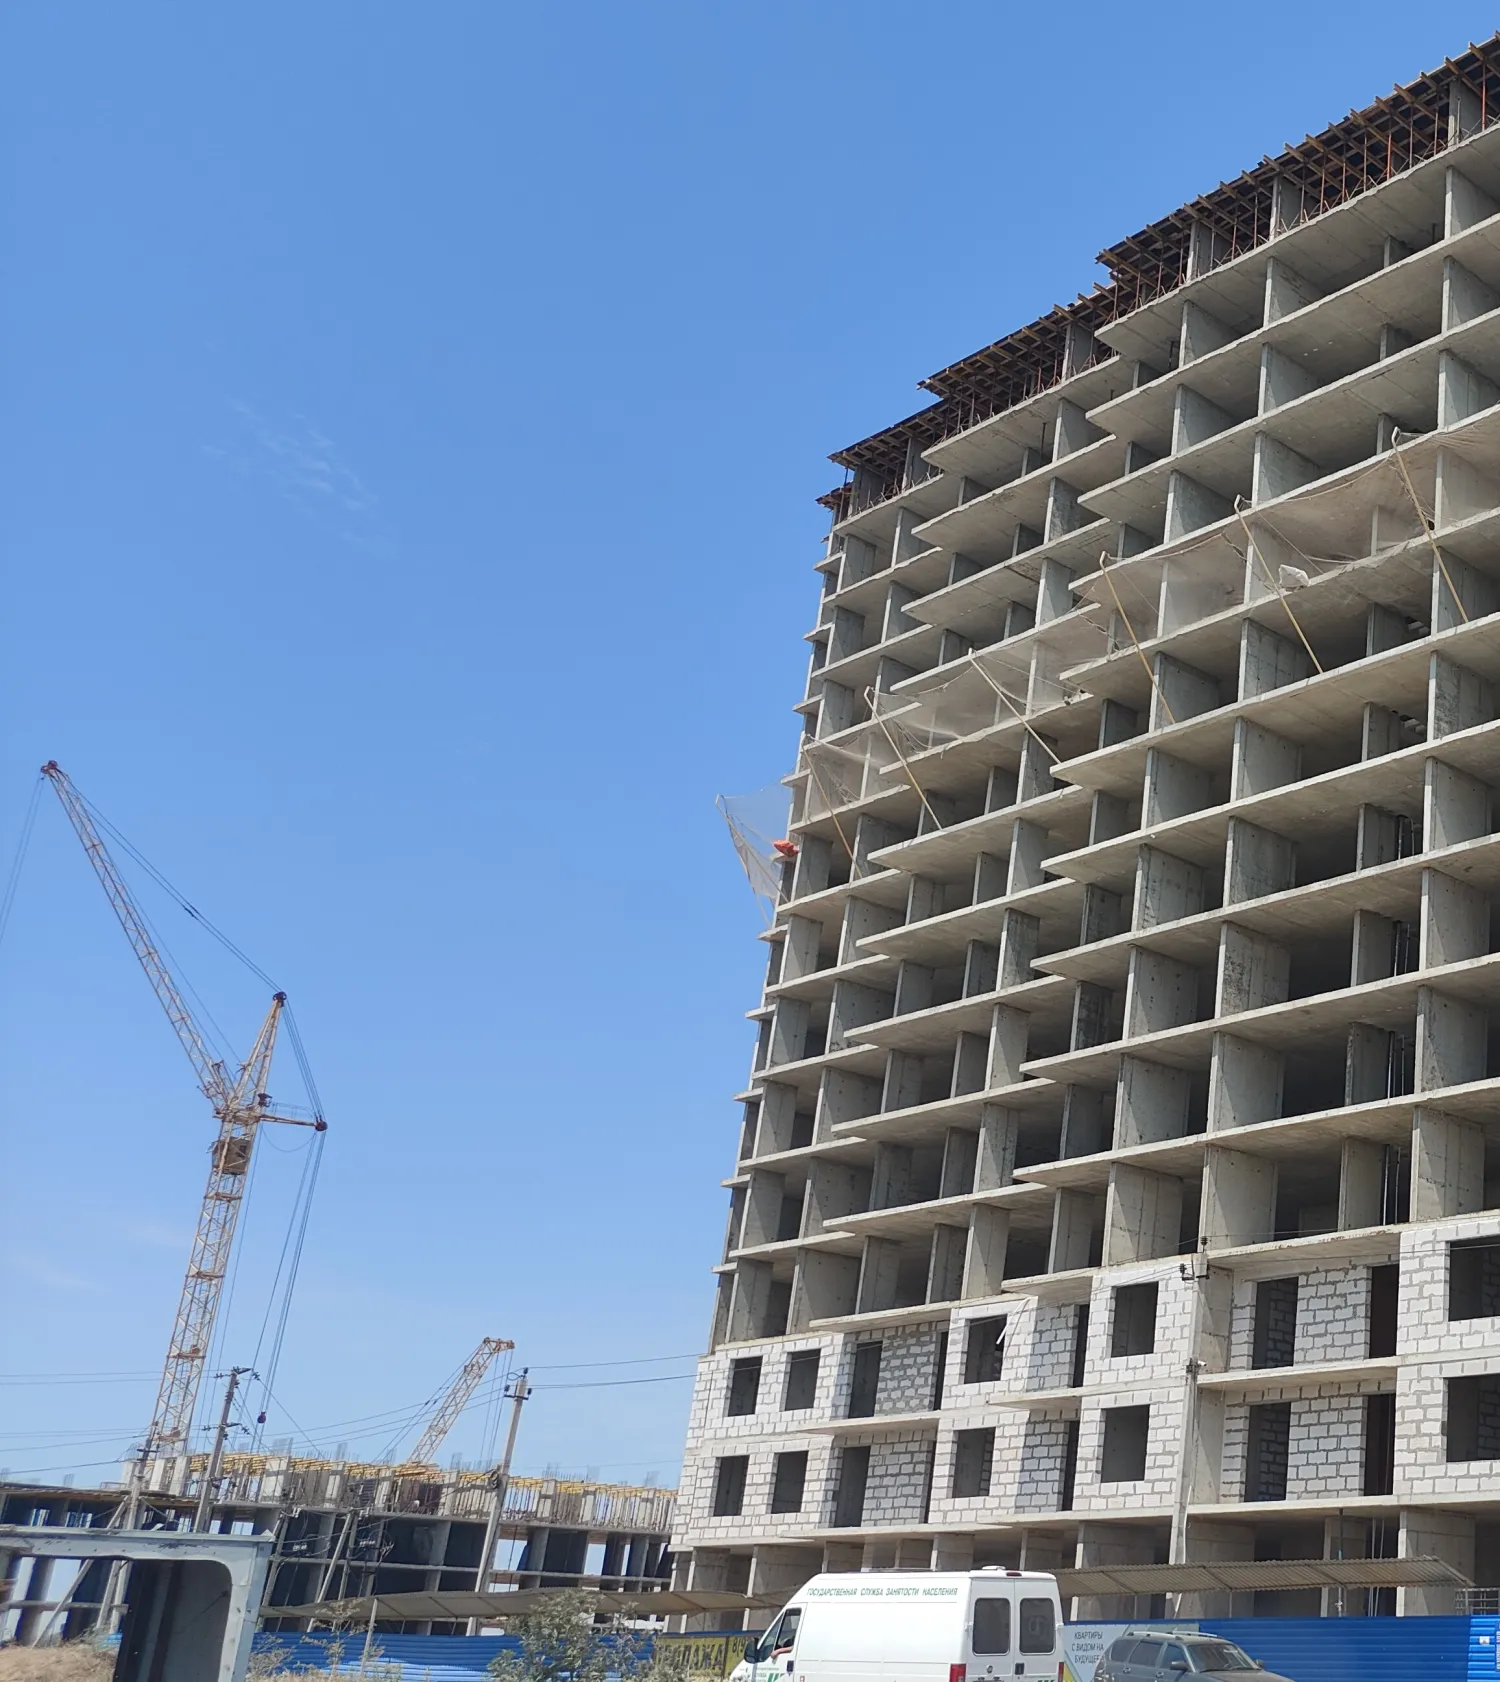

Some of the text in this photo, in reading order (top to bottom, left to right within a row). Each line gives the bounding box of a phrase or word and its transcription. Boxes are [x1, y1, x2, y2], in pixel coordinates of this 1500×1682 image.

[807, 1587, 959, 1597] ГОСУДАРСТВЕННАЯ СЛУЖБА ЗАНЯТОСТИ НАСЕЛЕНИЯ
[1074, 1631, 1103, 1640] КВАРТИРЫ
[1076, 1644, 1096, 1652] ВИДОМ
[1096, 1643, 1104, 1651] НА
